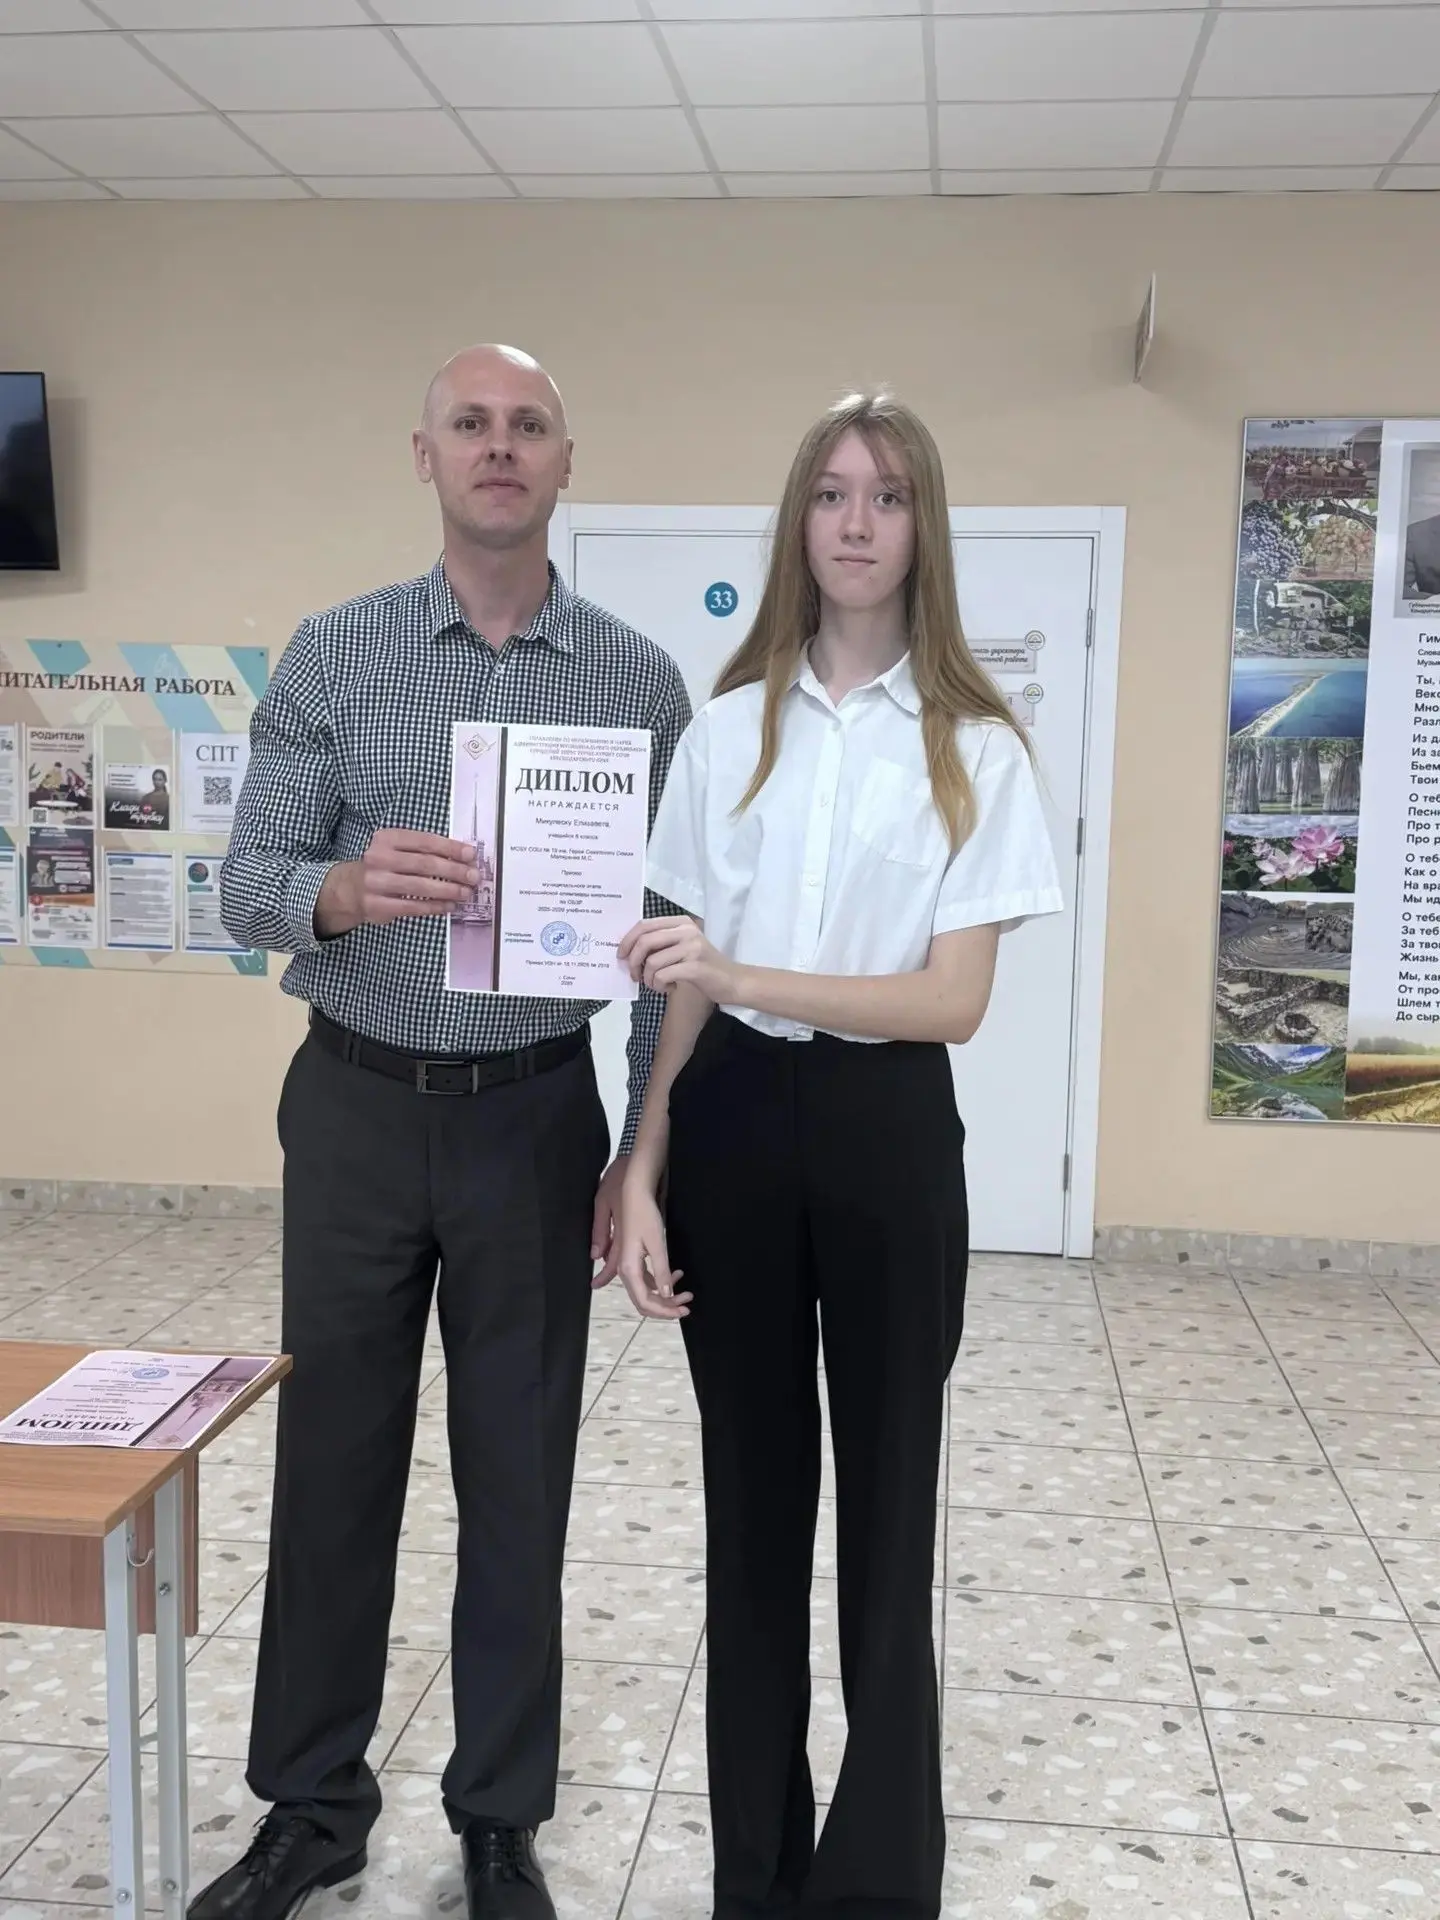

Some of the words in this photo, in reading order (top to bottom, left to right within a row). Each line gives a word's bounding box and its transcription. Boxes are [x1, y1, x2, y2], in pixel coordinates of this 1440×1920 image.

[710, 590, 733, 609] 33
[0, 672, 147, 693] ИТАТЕЛЬНАЯ
[155, 678, 237, 696] РАБОТА
[1416, 675, 1435, 685] Ты,
[1414, 703, 1439, 712] Мно
[30, 731, 85, 741] РОДИТЕЛИ
[1412, 733, 1428, 743] Из
[196, 744, 239, 762] СПТ
[1411, 747, 1427, 757] Из
[515, 768, 635, 795] ДИПЛОМ
[1410, 774, 1438, 784] Твои
[1409, 793, 1419, 803] О
[528, 800, 620, 811] НАГРАЖДАЕТСЯ
[1407, 820, 1431, 831] Про
[1406, 834, 1430, 845] Про
[1405, 853, 1415, 862] О
[1419, 854, 1440, 863] теб
[1404, 867, 1425, 877] Как
[1429, 868, 1437, 877] о
[1403, 881, 1419, 890] На
[1402, 894, 1422, 903] Мы
[1402, 912, 1412, 921] О
[1401, 925, 1415, 935] За
[1400, 939, 1415, 948] За
[1419, 940, 1440, 949] тво
[1400, 952, 1439, 962] Жизнь
[1398, 971, 1421, 982] Мы,
[1398, 984, 1413, 994] От
[1397, 998, 1431, 1008] Шлем
[1396, 1011, 1413, 1021] До
[16, 1417, 144, 1431] ДИПЛОМ
